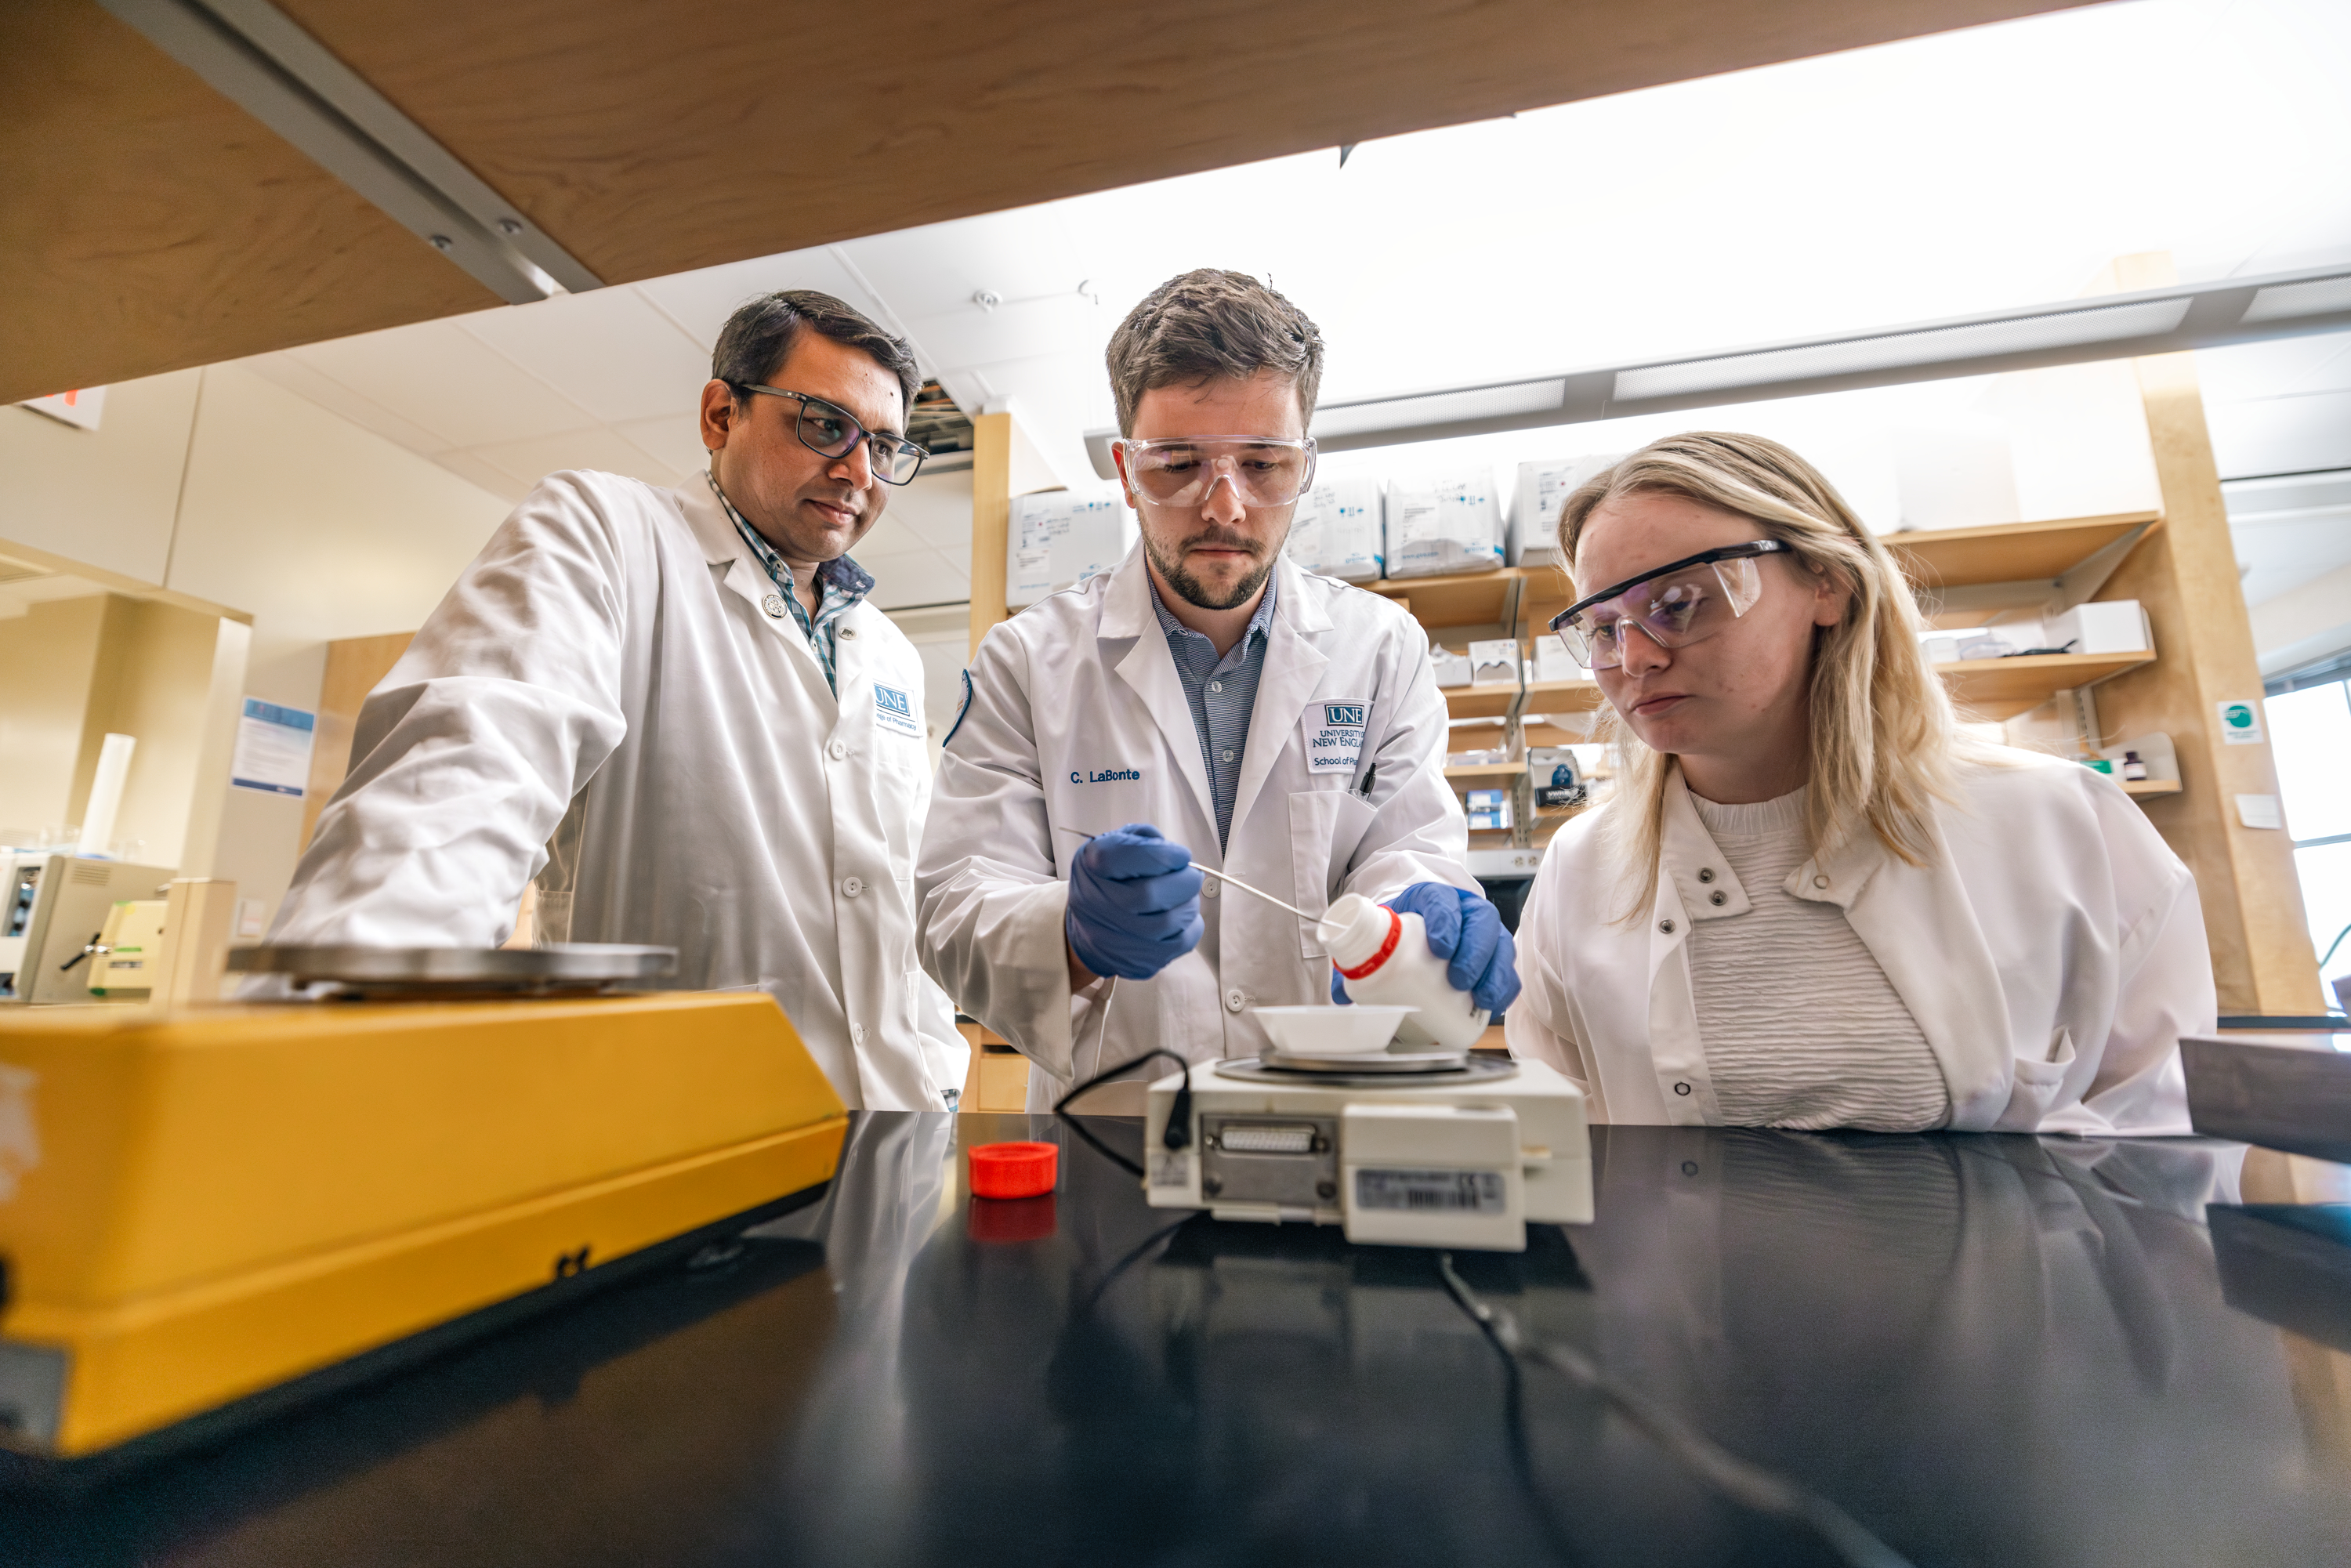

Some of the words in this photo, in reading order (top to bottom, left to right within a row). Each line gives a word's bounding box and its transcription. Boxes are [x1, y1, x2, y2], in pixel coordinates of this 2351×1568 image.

[1329, 708, 1362, 722] UNE
[892, 717, 917, 731] Pharmacy
[1313, 737, 1337, 748] NEW
[1314, 756, 1341, 766] School
[1342, 756, 1349, 765] of
[1070, 771, 1083, 784] C.
[1089, 769, 1140, 783] LaBonte
